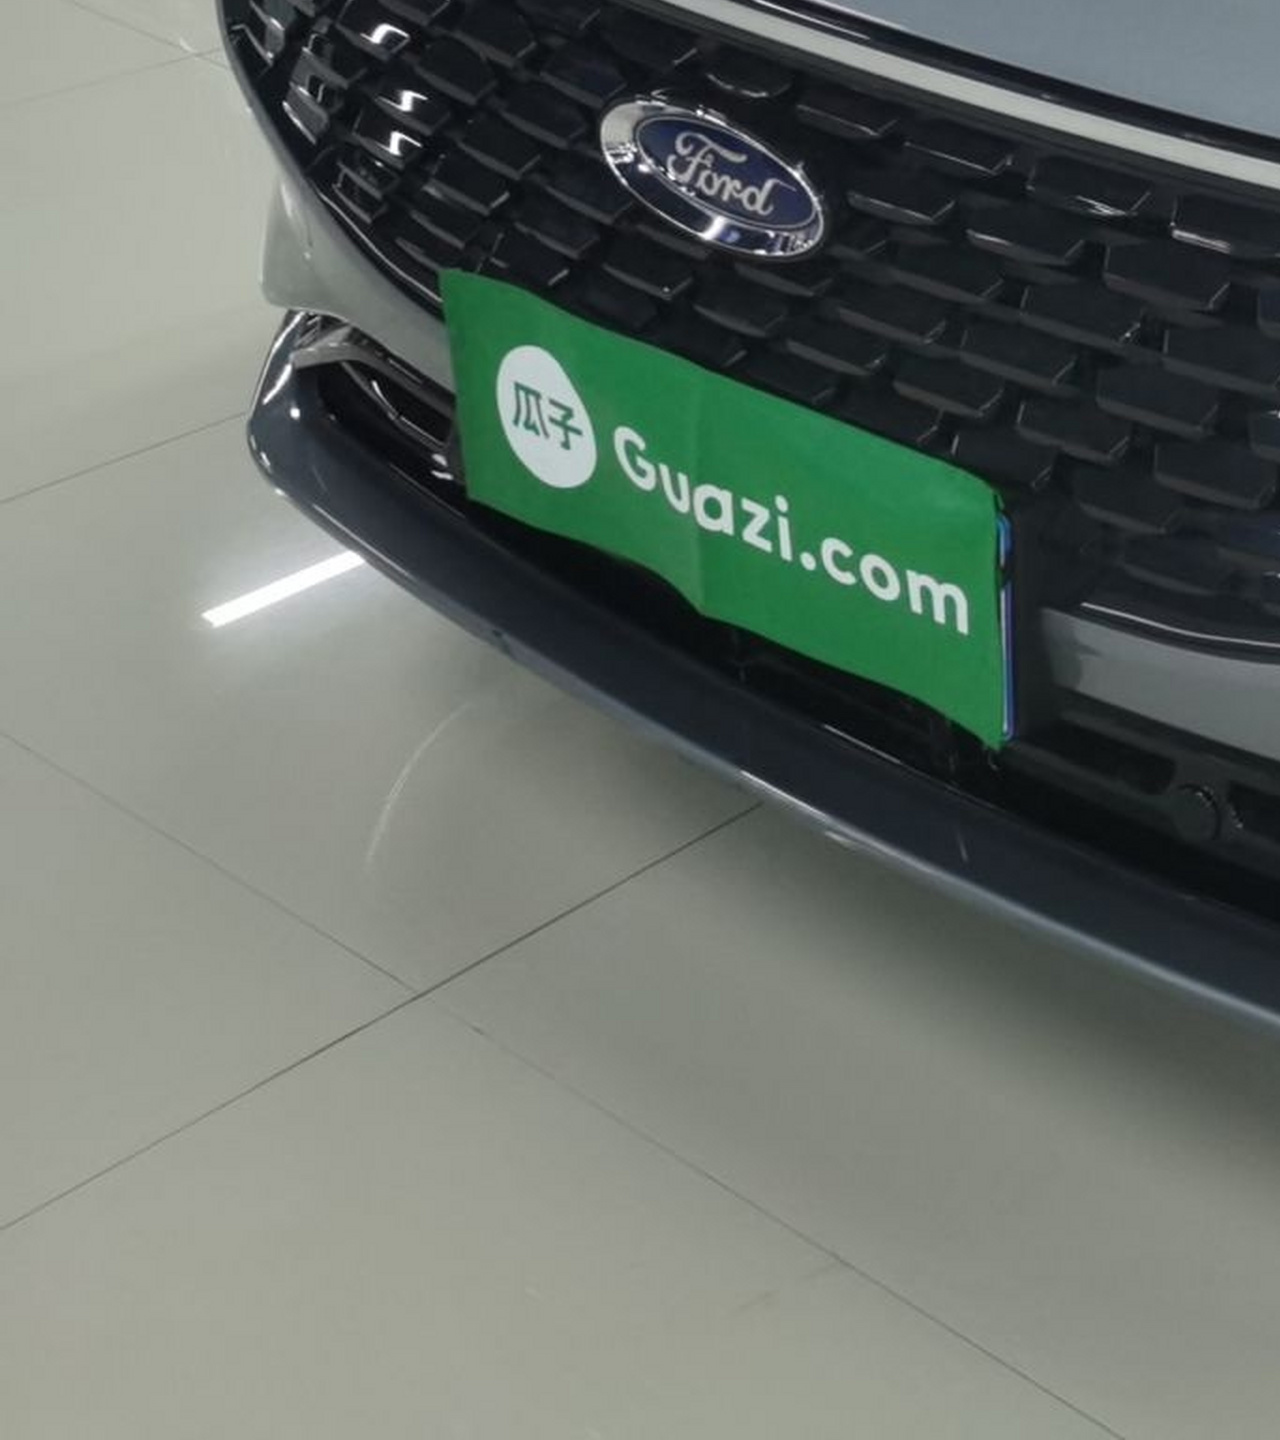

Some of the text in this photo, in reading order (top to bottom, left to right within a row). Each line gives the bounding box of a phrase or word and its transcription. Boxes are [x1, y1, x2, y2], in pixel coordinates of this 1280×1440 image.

[666, 131, 797, 216] Ford
[511, 381, 584, 451] 瓜子
[613, 426, 970, 637] Guazi.com
